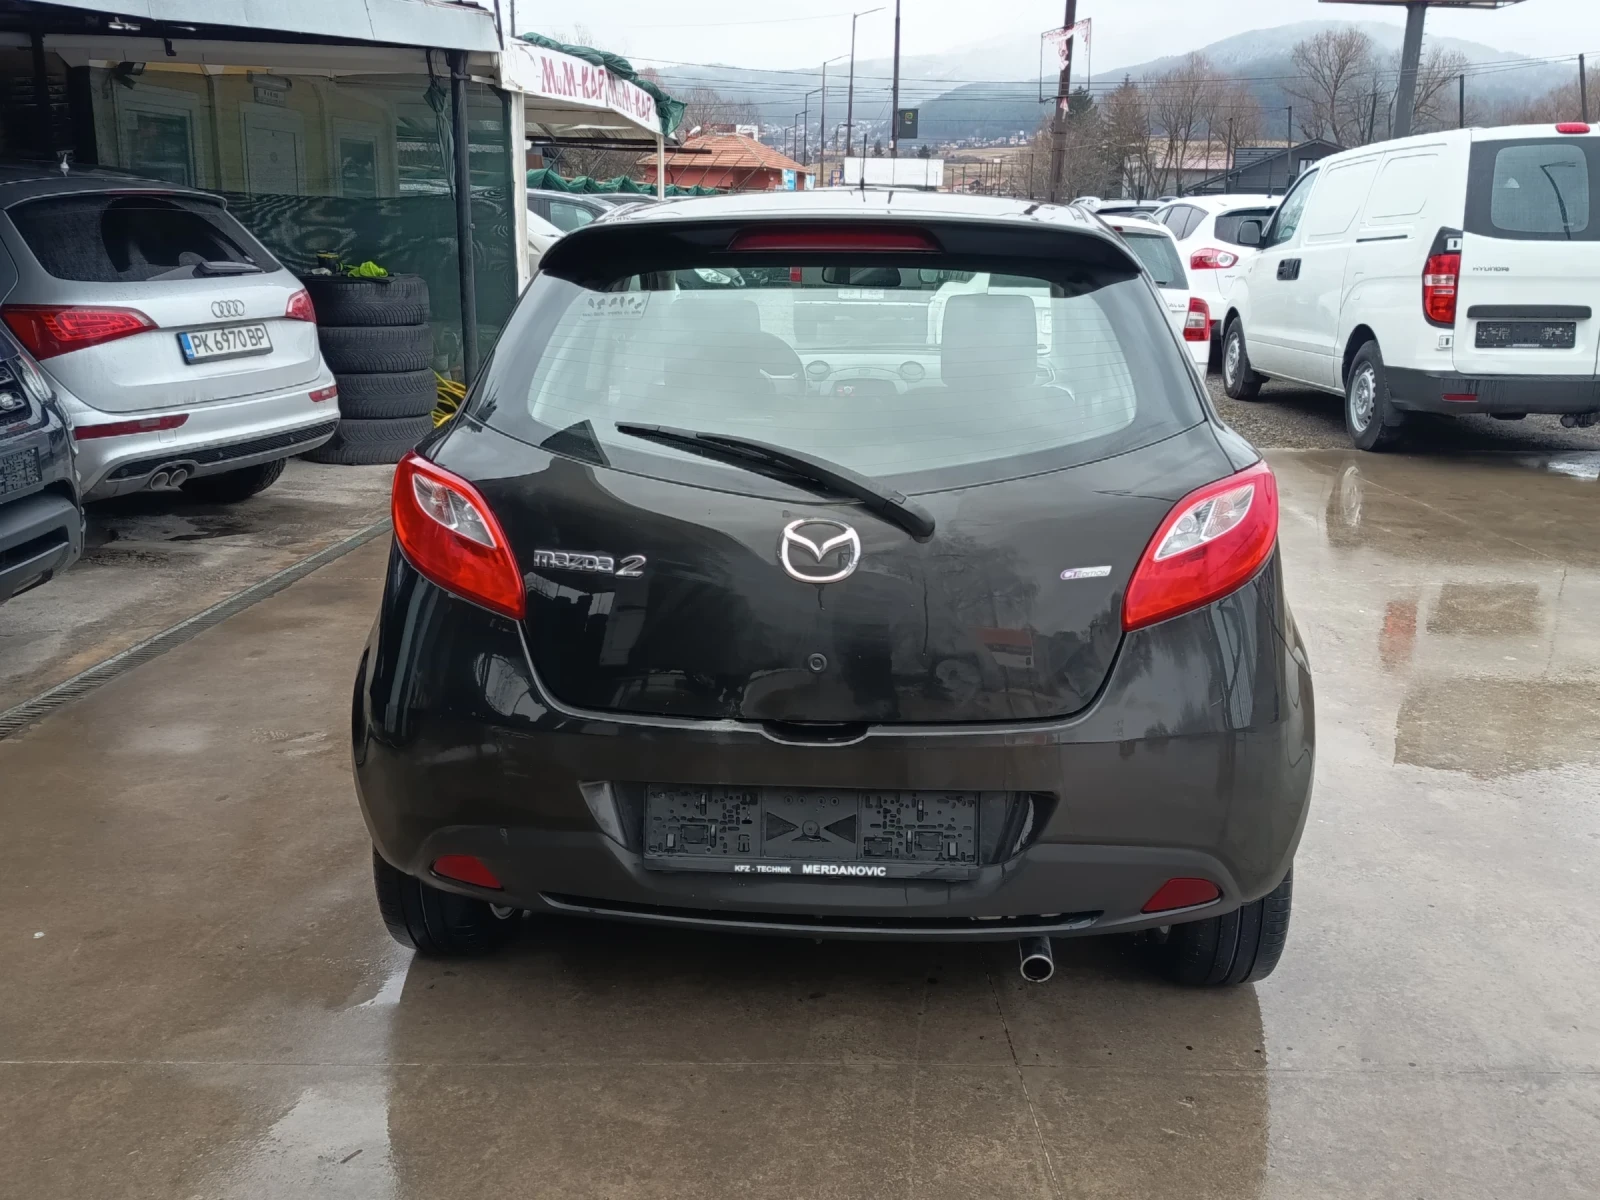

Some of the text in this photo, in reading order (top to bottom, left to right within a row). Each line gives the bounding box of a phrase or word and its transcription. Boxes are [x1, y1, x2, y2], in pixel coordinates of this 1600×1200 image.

[615, 554, 647, 577] 2
[734, 864, 750, 873] KFZ
[756, 865, 791, 874] TECHNIK
[802, 864, 887, 877] MERDANOVIC
